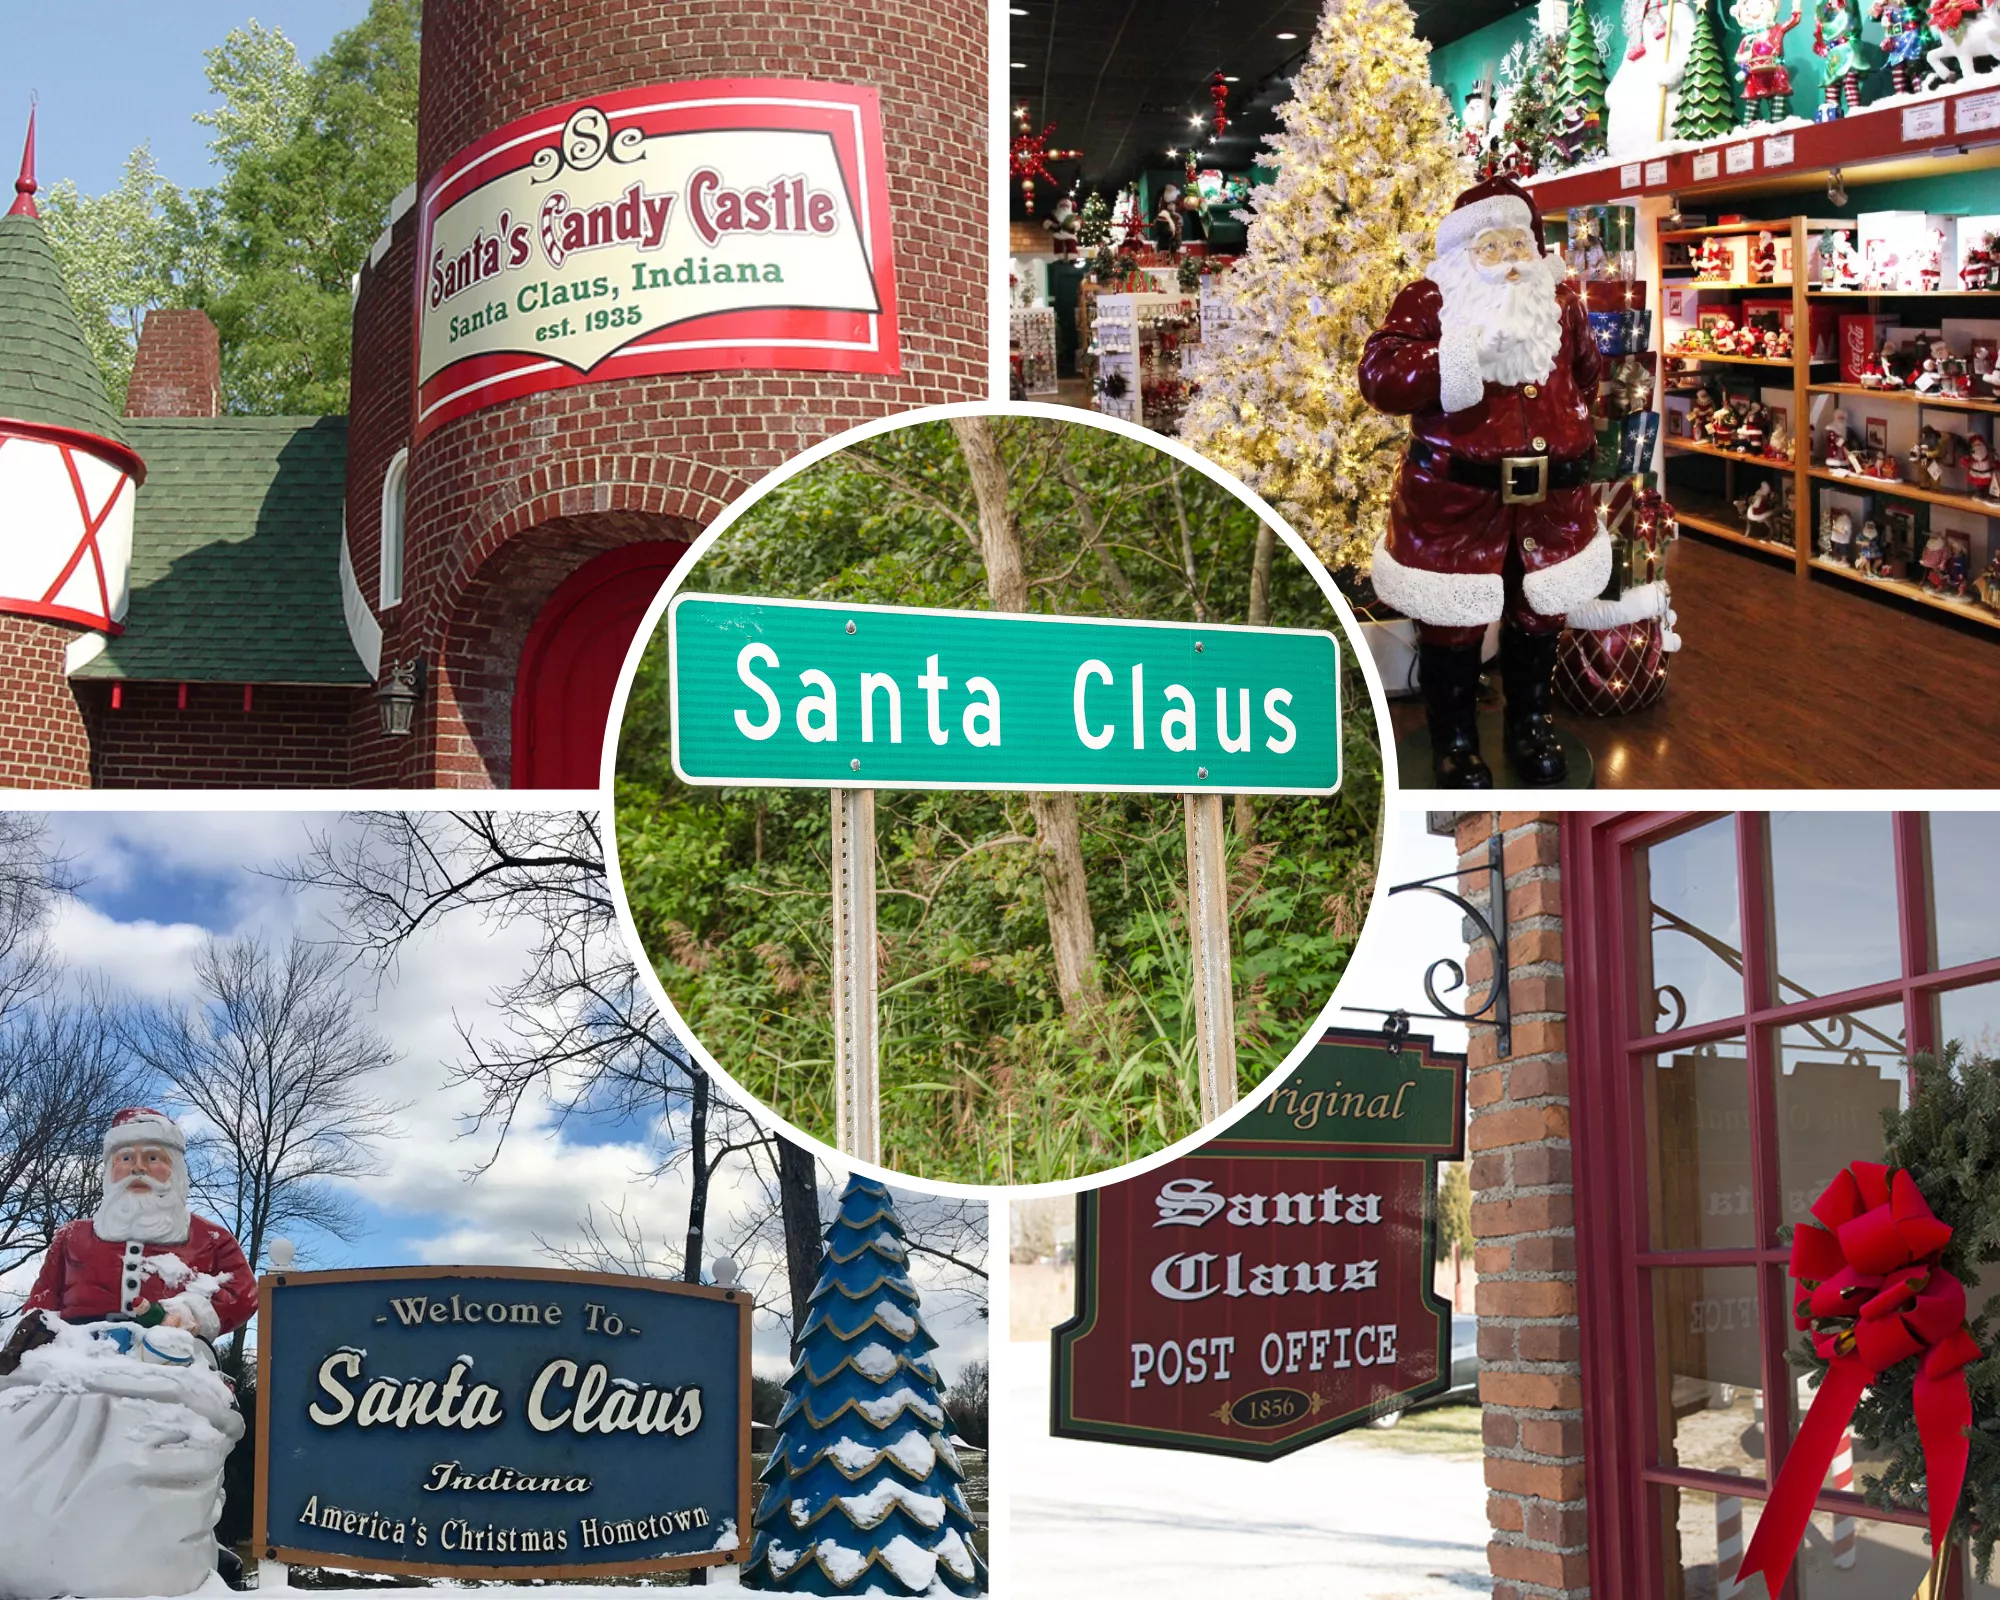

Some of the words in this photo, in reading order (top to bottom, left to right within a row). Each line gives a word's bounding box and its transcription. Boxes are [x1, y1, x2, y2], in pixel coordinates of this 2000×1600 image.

[431, 213, 530, 307] Santa's
[540, 184, 674, 265] Candy
[688, 171, 837, 244] Castle
[449, 300, 508, 343] Santa
[517, 273, 620, 312] Claus,
[631, 257, 784, 291] Indiana
[535, 318, 576, 342] est.
[585, 305, 643, 333] 1935
[733, 642, 1001, 747] Santa
[1074, 659, 1297, 754] Claus
[1256, 1079, 1416, 1130] riginal
[1153, 1178, 1383, 1228] Santa
[1150, 1251, 1379, 1301] Claus
[1130, 1336, 1235, 1388] POST
[1260, 1324, 1398, 1376] OFFICE
[308, 1350, 502, 1429] Santa
[527, 1358, 703, 1437] Claus
[1248, 1397, 1295, 1421] 1856
[423, 1462, 591, 1493] Indiana
[300, 1495, 427, 1547] America's
[441, 1519, 568, 1553] Christmas
[580, 1506, 709, 1549] Hometown
